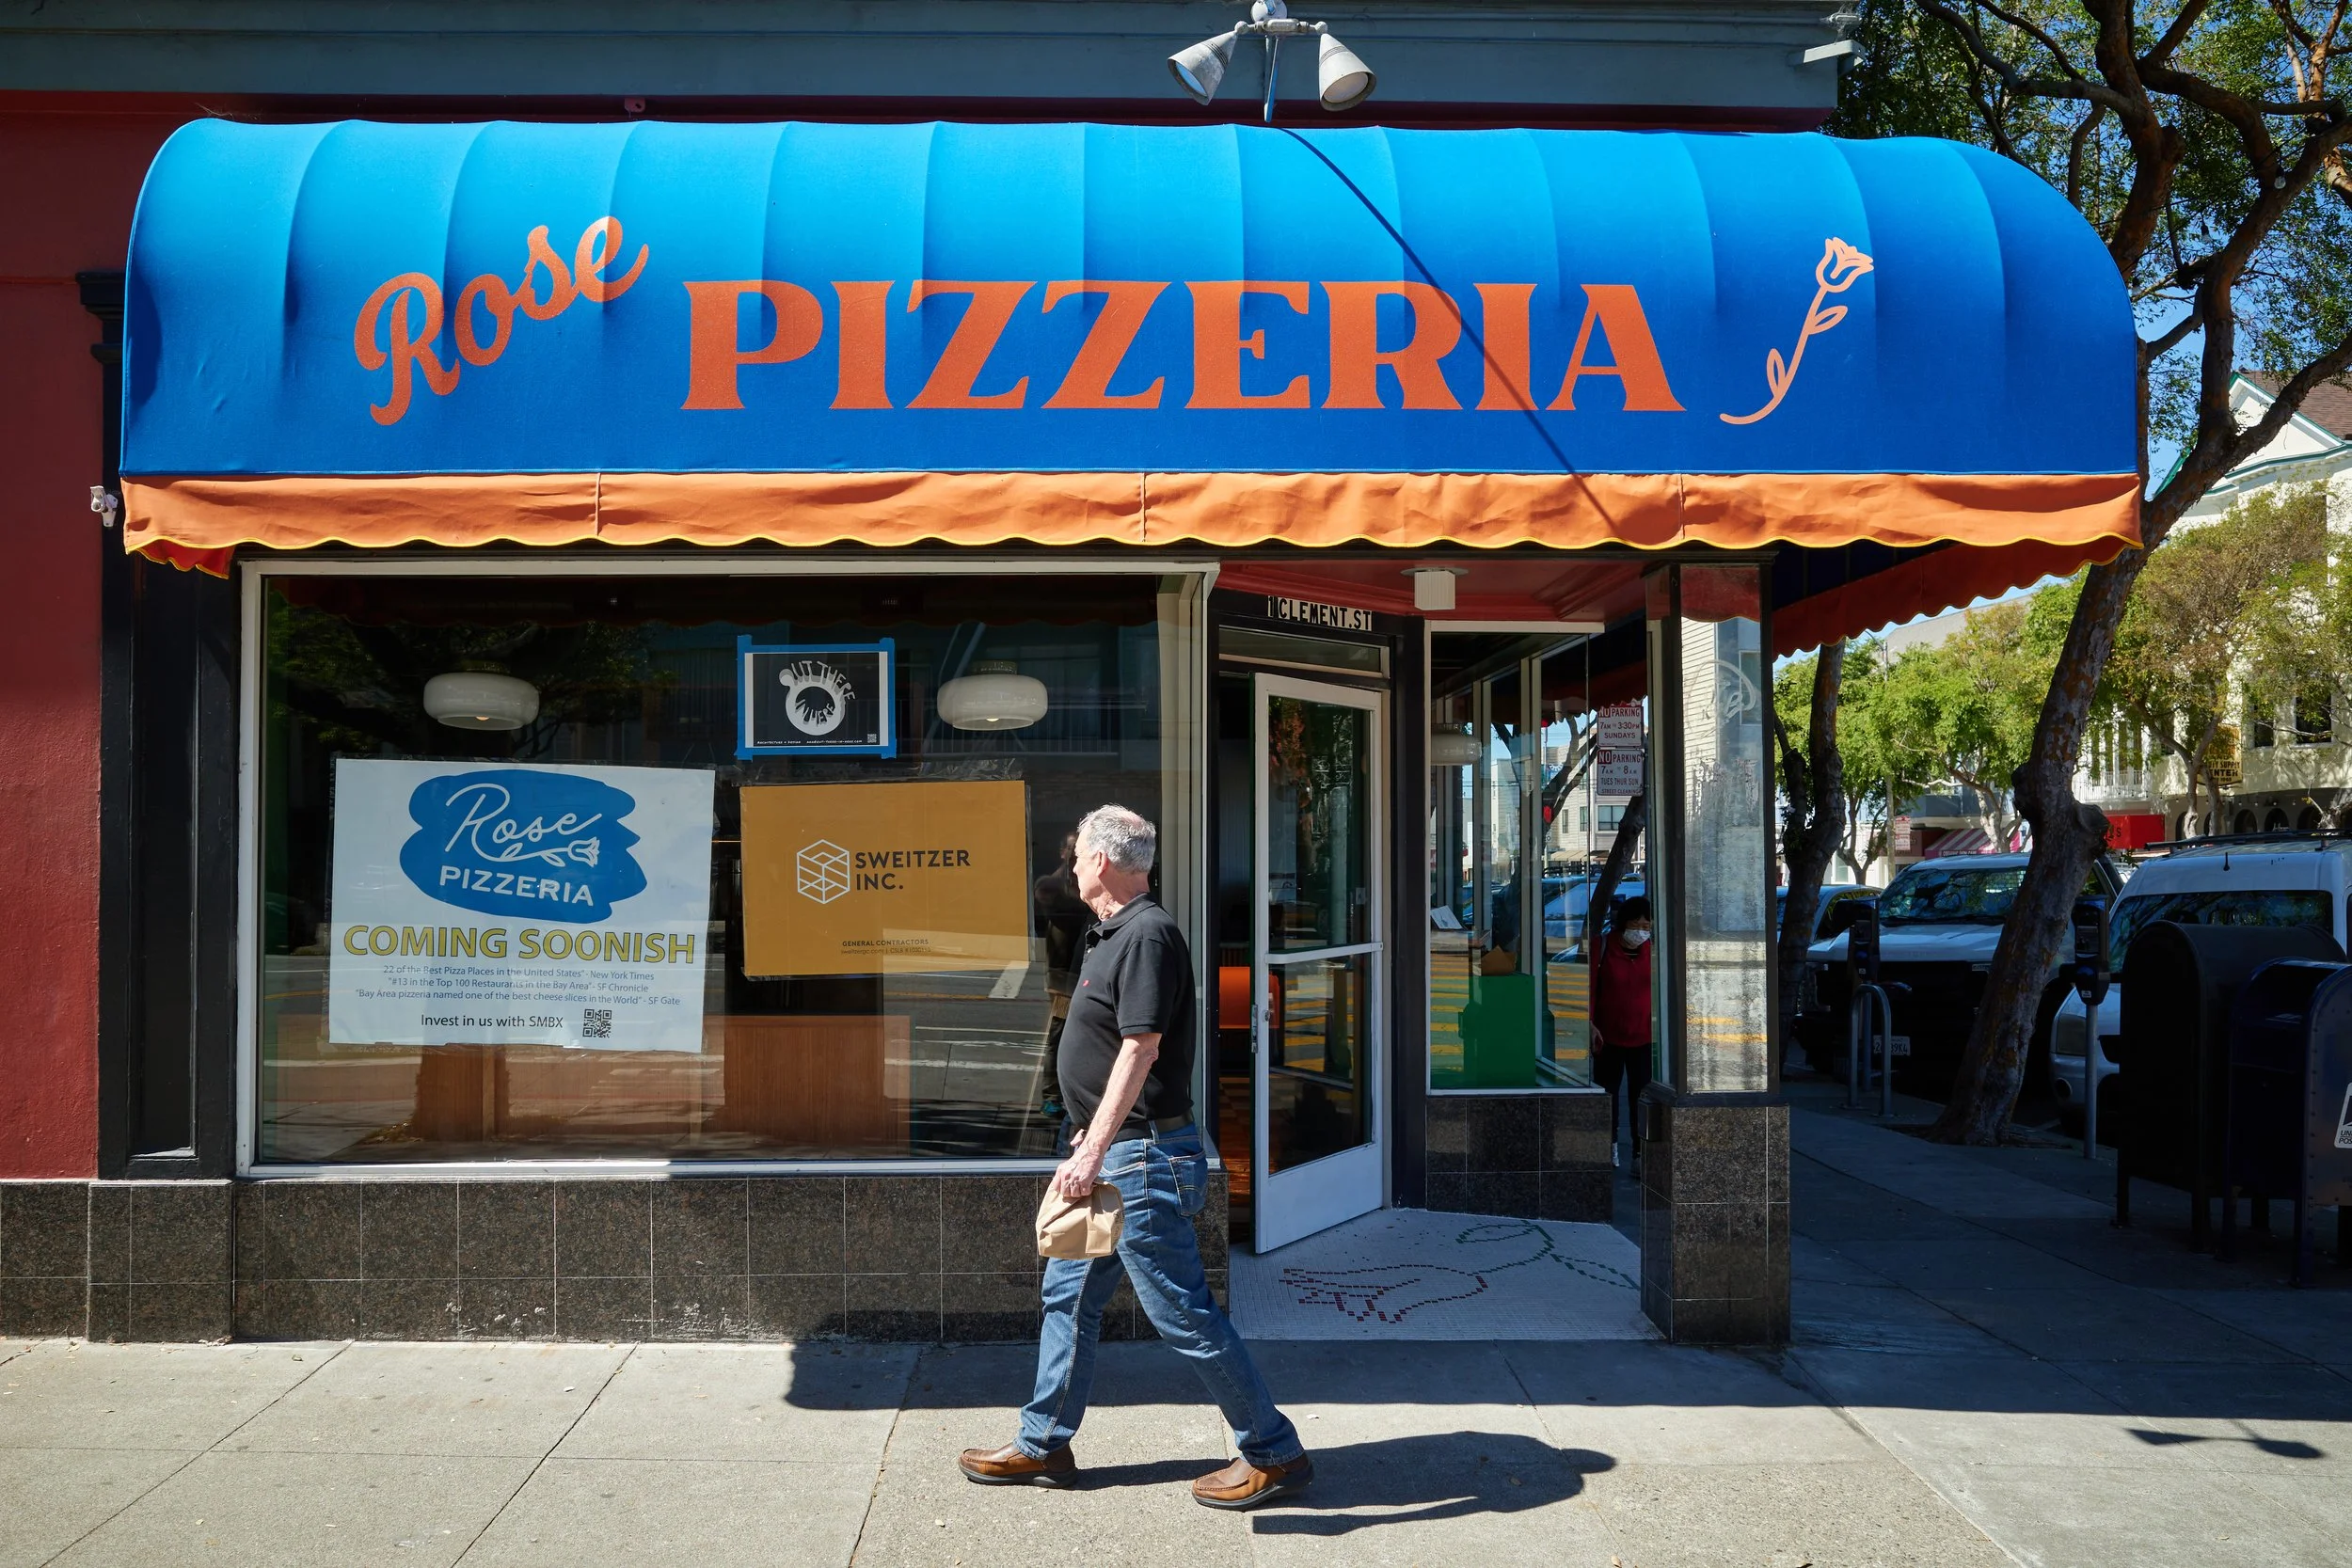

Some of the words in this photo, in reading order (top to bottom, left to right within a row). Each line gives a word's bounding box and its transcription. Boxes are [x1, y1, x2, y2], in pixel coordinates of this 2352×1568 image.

[354, 215, 649, 426] Rose
[681, 279, 1688, 411] PIZZERIA
[817, 660, 856, 700] THERE
[1612, 707, 1640, 717] PARKING
[1599, 751, 1611, 763] NO
[1613, 753, 1641, 764] PARKING
[1600, 777, 1613, 785] TUES
[445, 783, 603, 859] Rose
[855, 849, 971, 869] SWEITZER
[439, 865, 595, 907] PIZZERIA
[856, 873, 903, 890] INC.
[343, 925, 508, 958] COMING
[518, 928, 695, 964] SOONISH
[384, 965, 393, 974] 22
[397, 965, 406, 974] of
[406, 966, 421, 974] the
[423, 966, 442, 974] Best
[469, 967, 495, 975] Places
[497, 967, 504, 975] in
[507, 967, 521, 976] the
[611, 971, 628, 979] York
[629, 971, 655, 980] Times
[437, 978, 453, 988] Top
[455, 978, 469, 988] 100
[472, 979, 523, 988] Restaurants
[536, 980, 551, 989] the
[553, 981, 567, 991] Bay
[597, 982, 607, 990] SF
[608, 983, 649, 992] Chronicle
[376, 990, 396, 998] Area
[399, 990, 431, 1001] pizzeria
[433, 990, 463, 999] named
[495, 991, 510, 1000] the
[512, 991, 531, 1001] best
[564, 993, 587, 1003] slices
[589, 994, 596, 1003] in
[660, 997, 681, 1006] Gate
[421, 1014, 459, 1026] Invest
[463, 1015, 474, 1026] in
[479, 1019, 493, 1027] us
[497, 1016, 525, 1027] with
[529, 1016, 564, 1028] SMBX
